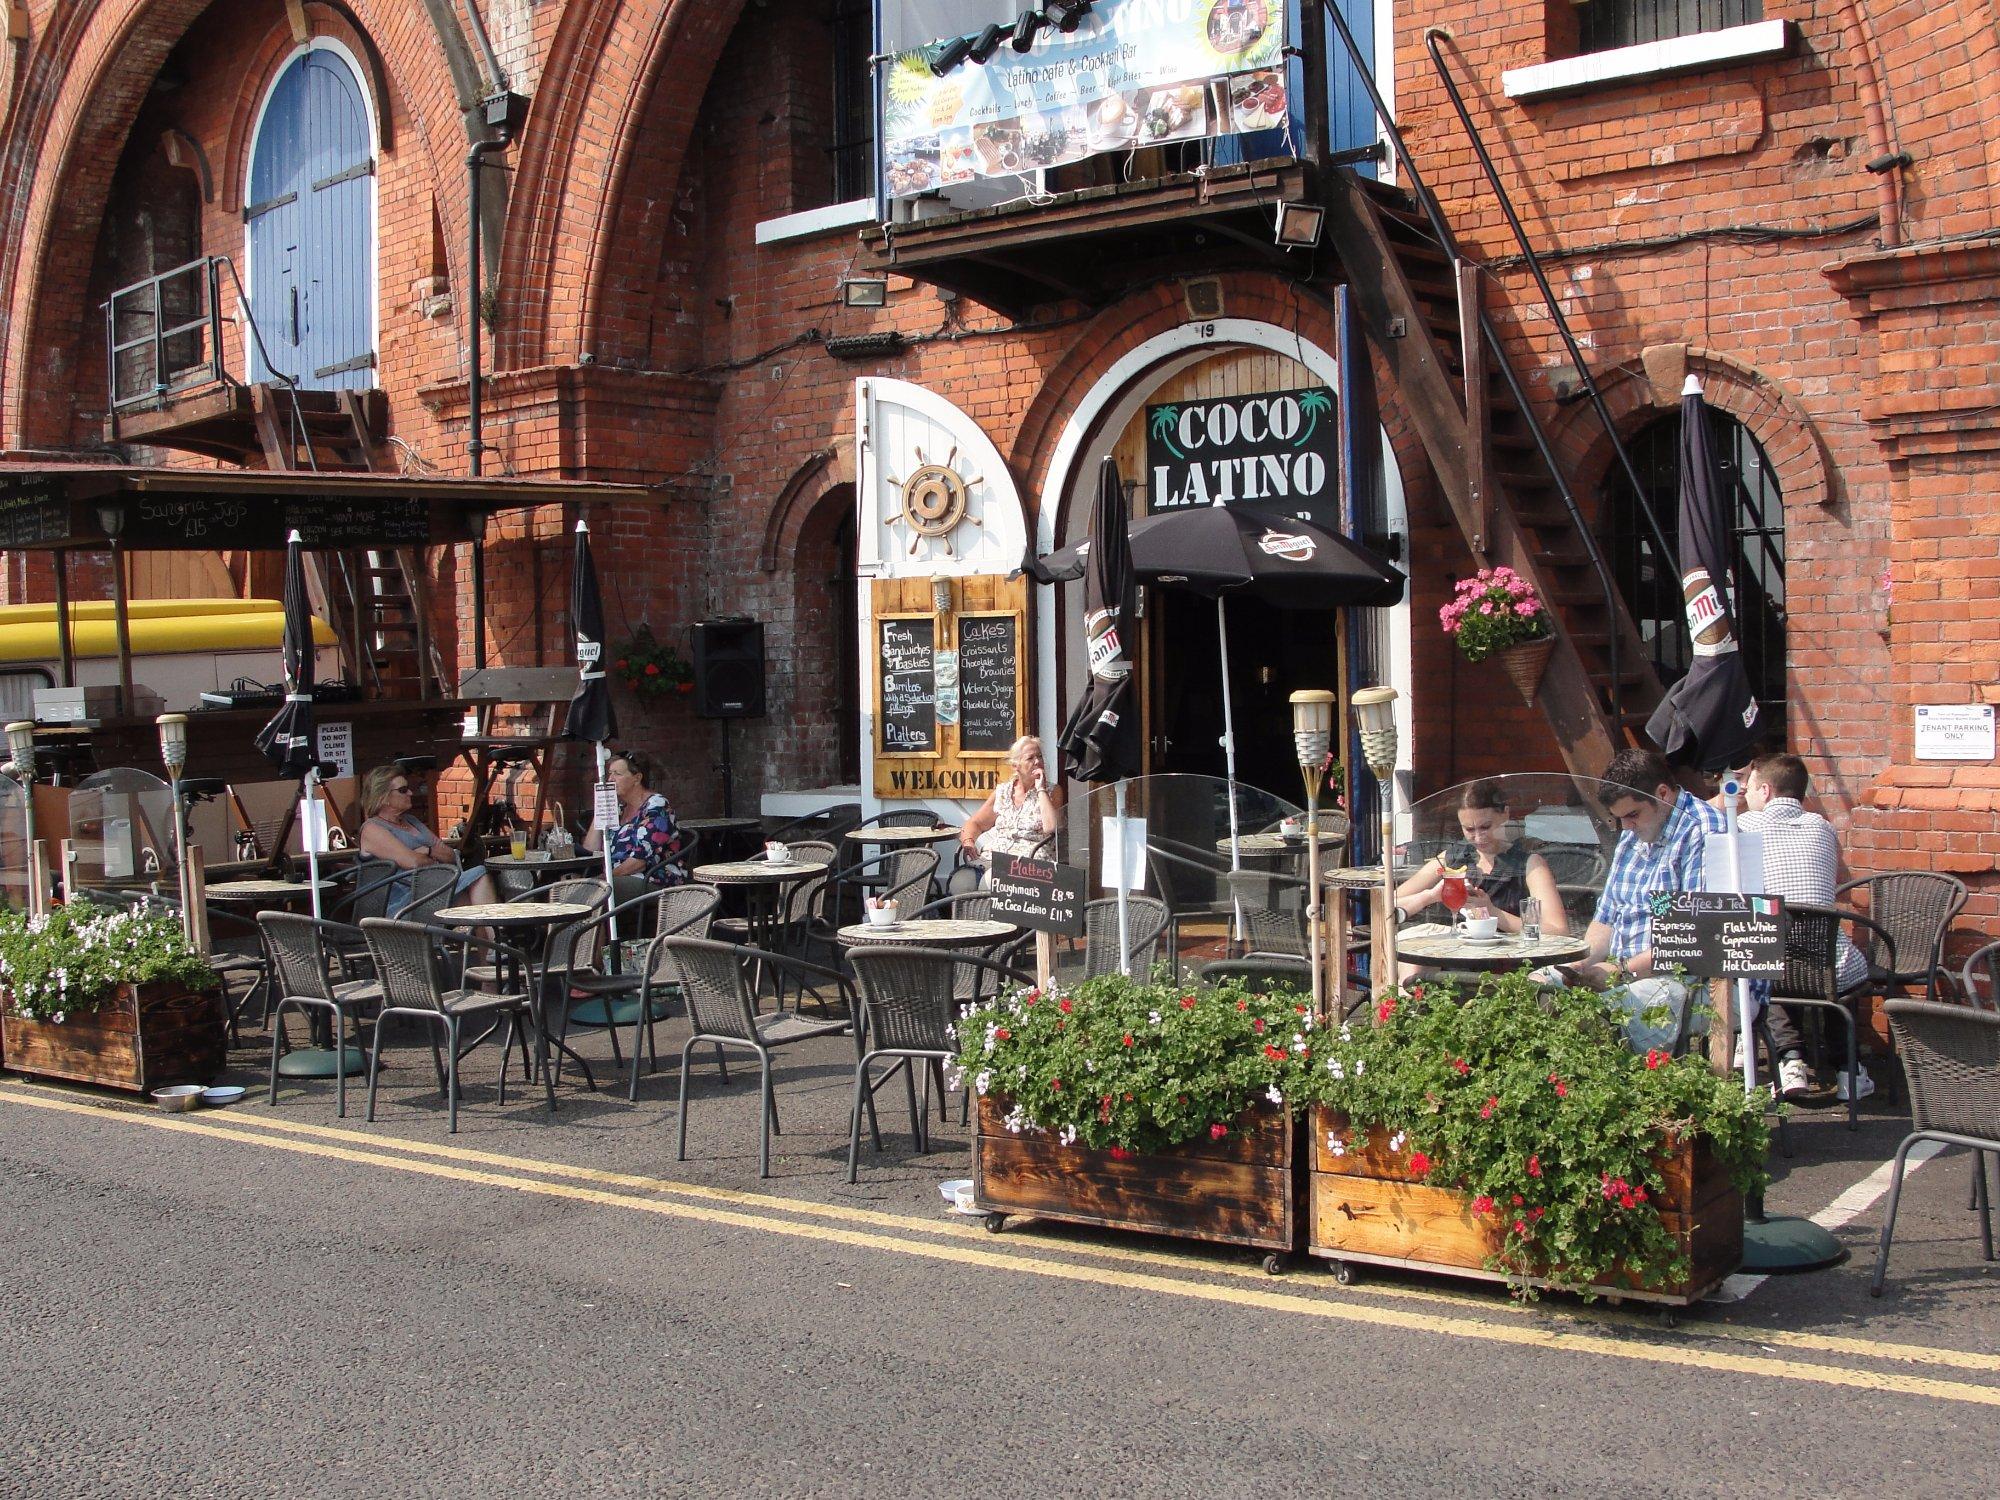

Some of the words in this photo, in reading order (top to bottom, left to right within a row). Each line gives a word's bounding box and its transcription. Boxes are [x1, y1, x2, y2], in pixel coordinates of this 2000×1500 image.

[1042, 61, 1064, 82] café
[1069, 58, 1077, 75] &
[1081, 49, 1119, 72] Cocktail
[1122, 43, 1137, 60] Bar
[969, 104, 1001, 117] Cocktails
[1045, 91, 1067, 103] Coffee
[1080, 85, 1096, 95] Beer
[1123, 71, 1142, 81] Bites
[1201, 323, 1215, 338] 19
[1178, 396, 1301, 450] COCO
[1153, 451, 1326, 507] LATINO
[139, 499, 209, 526] Sangria
[213, 500, 248, 527] Jugs
[185, 518, 207, 538] £15
[883, 621, 913, 644] Fresh
[963, 621, 1006, 640] Cakes
[882, 643, 931, 659] Sandwiches
[960, 643, 1008, 656] Croissants
[892, 656, 930, 670] Toasties
[961, 657, 995, 669] Chocolate
[979, 667, 1015, 679] Brownies
[884, 674, 922, 693] Burritos
[962, 682, 991, 695] Victoria
[991, 680, 1014, 698] Sponge
[962, 699, 990, 710] Chocolate
[991, 698, 1008, 710] Cake
[321, 725, 347, 733] PLEASE
[886, 723, 926, 742] Platters
[890, 770, 1000, 790] WELCOME
[1010, 860, 1053, 880] Platters
[991, 877, 1040, 898] Ploughman's
[1051, 888, 1075, 902] £8.95
[990, 897, 1004, 910] The
[1004, 899, 1021, 912] Coco
[1049, 907, 1073, 922] £11.95
[1677, 895, 1713, 916] Coffee
[1727, 898, 1748, 910] Tea
[1652, 918, 1696, 934] Espresso
[1723, 922, 1746, 934] Flat
[1747, 921, 1777, 932] White
[1651, 934, 1697, 945] Macchiato
[1722, 933, 1778, 948] Cappuccino
[1652, 946, 1703, 959] Americano
[1723, 948, 1754, 960] Tea's
[1652, 960, 1677, 971] Latt
[1723, 960, 1740, 971] Hot
[1741, 960, 1785, 971] Chocolate
